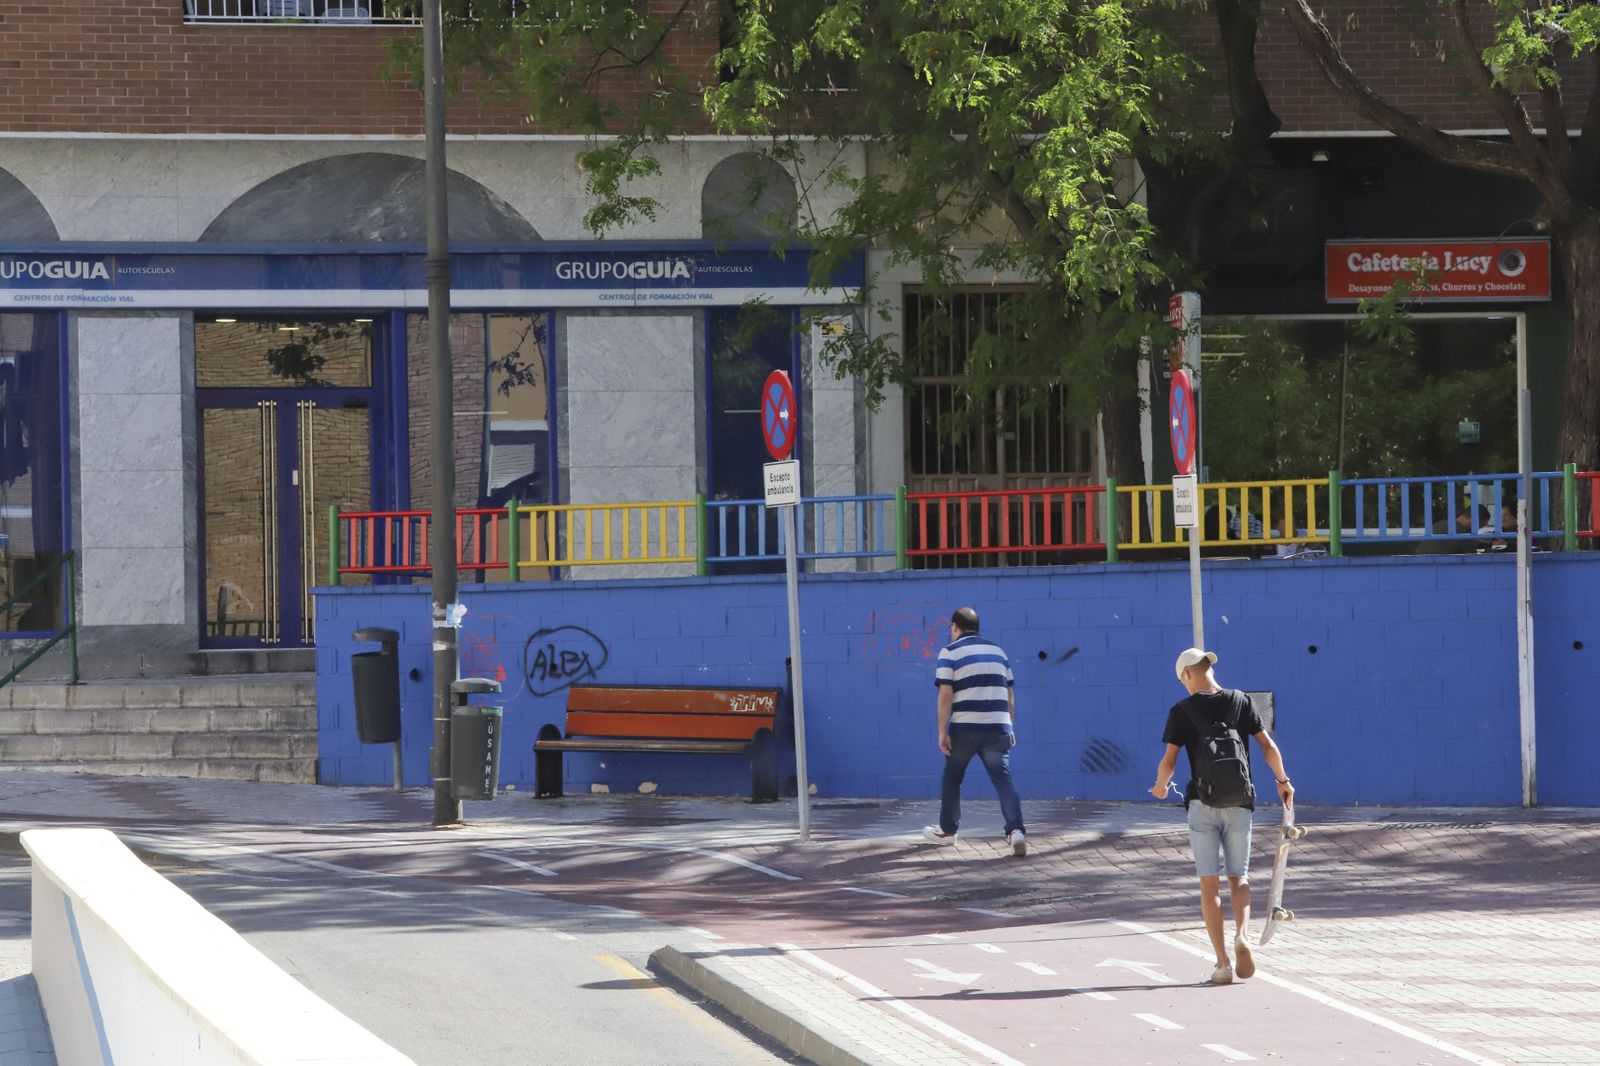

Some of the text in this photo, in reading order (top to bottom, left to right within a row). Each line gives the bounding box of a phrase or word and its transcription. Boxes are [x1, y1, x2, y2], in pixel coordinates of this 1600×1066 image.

[1443, 251, 1492, 275] Lucy
[555, 260, 690, 280] GRUPOGUIA
[697, 265, 753, 273] AUTOESCUELAS
[1442, 282, 1476, 291] Churros
[1477, 284, 1483, 292] y
[1484, 282, 1526, 291] Chocolate
[14, 294, 51, 302] CENTROS
[54, 294, 64, 302] DE
[66, 294, 116, 303] FORMACIÓN
[649, 292, 696, 300] FORMACIÓN
